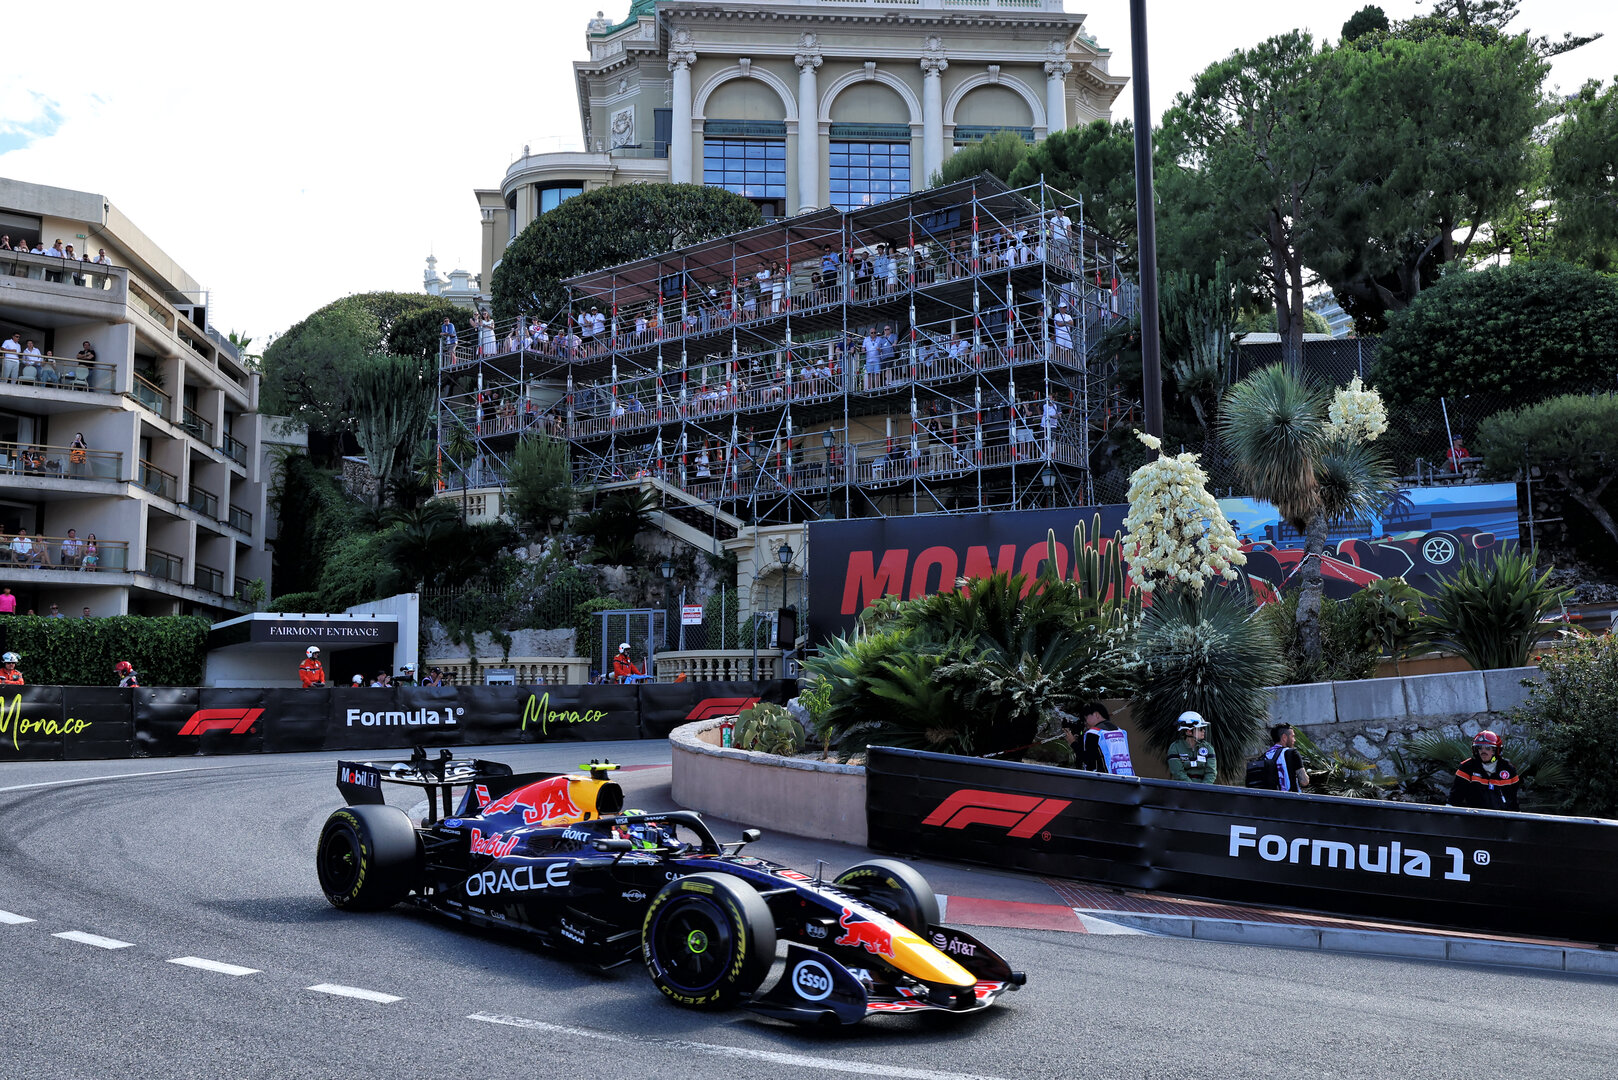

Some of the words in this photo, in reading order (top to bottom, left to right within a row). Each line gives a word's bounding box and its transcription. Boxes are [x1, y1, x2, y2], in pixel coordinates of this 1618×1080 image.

[270, 626, 324, 636] FAIRMONT
[326, 627, 379, 636] ENTRANCE
[0, 693, 92, 750] Monaco
[346, 707, 440, 727] Formula
[521, 691, 608, 735] Monaco
[341, 767, 367, 787] Mobil
[615, 817, 629, 825] VISA
[561, 828, 591, 843] ROKT
[1229, 824, 1431, 878] Formula
[466, 862, 571, 896] ORACLE
[949, 939, 976, 957] AT&T
